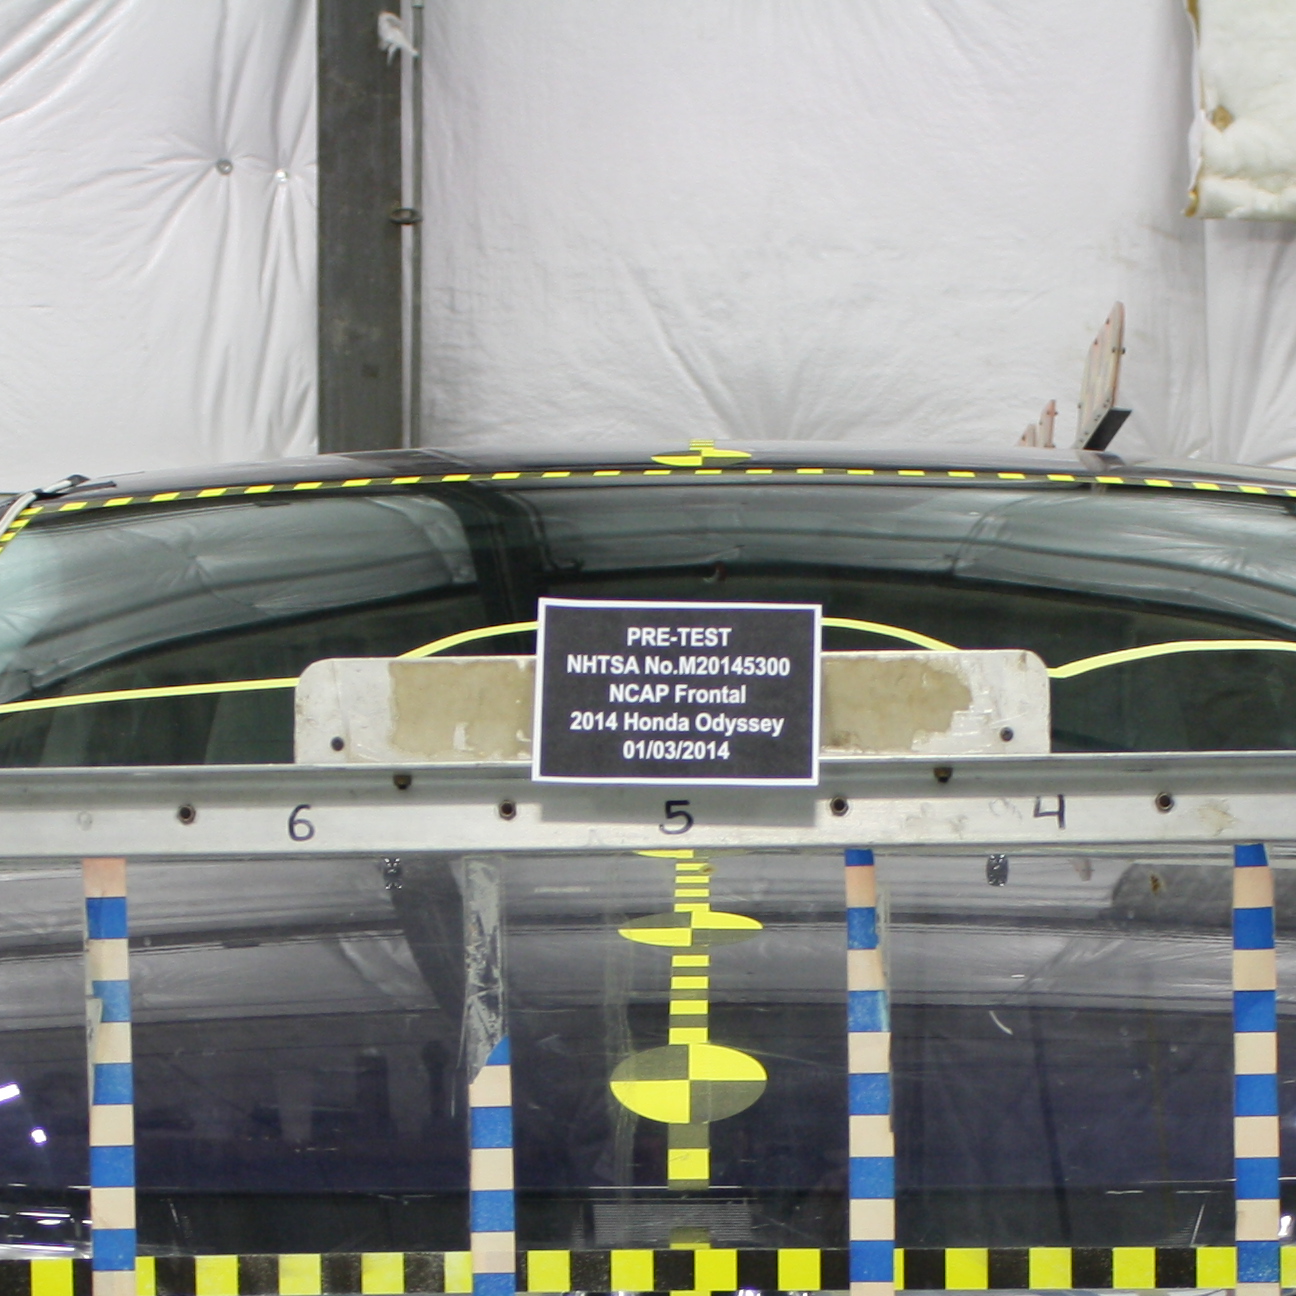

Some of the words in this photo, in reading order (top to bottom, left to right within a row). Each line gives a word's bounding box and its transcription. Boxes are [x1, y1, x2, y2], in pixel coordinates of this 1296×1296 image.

[627, 627, 732, 647] PRE-TEST
[567, 654, 640, 675] NHTSA
[645, 655, 791, 677] No.M20145300
[609, 683, 669, 703] NCAP
[674, 684, 747, 704] Frontal
[570, 711, 618, 731] 2014
[624, 711, 690, 731] Honda
[695, 712, 785, 737] Odyssey
[623, 740, 730, 760] 01/03/2014
[287, 803, 316, 842] 6
[659, 799, 694, 834] 5
[1032, 793, 1066, 829] 4
